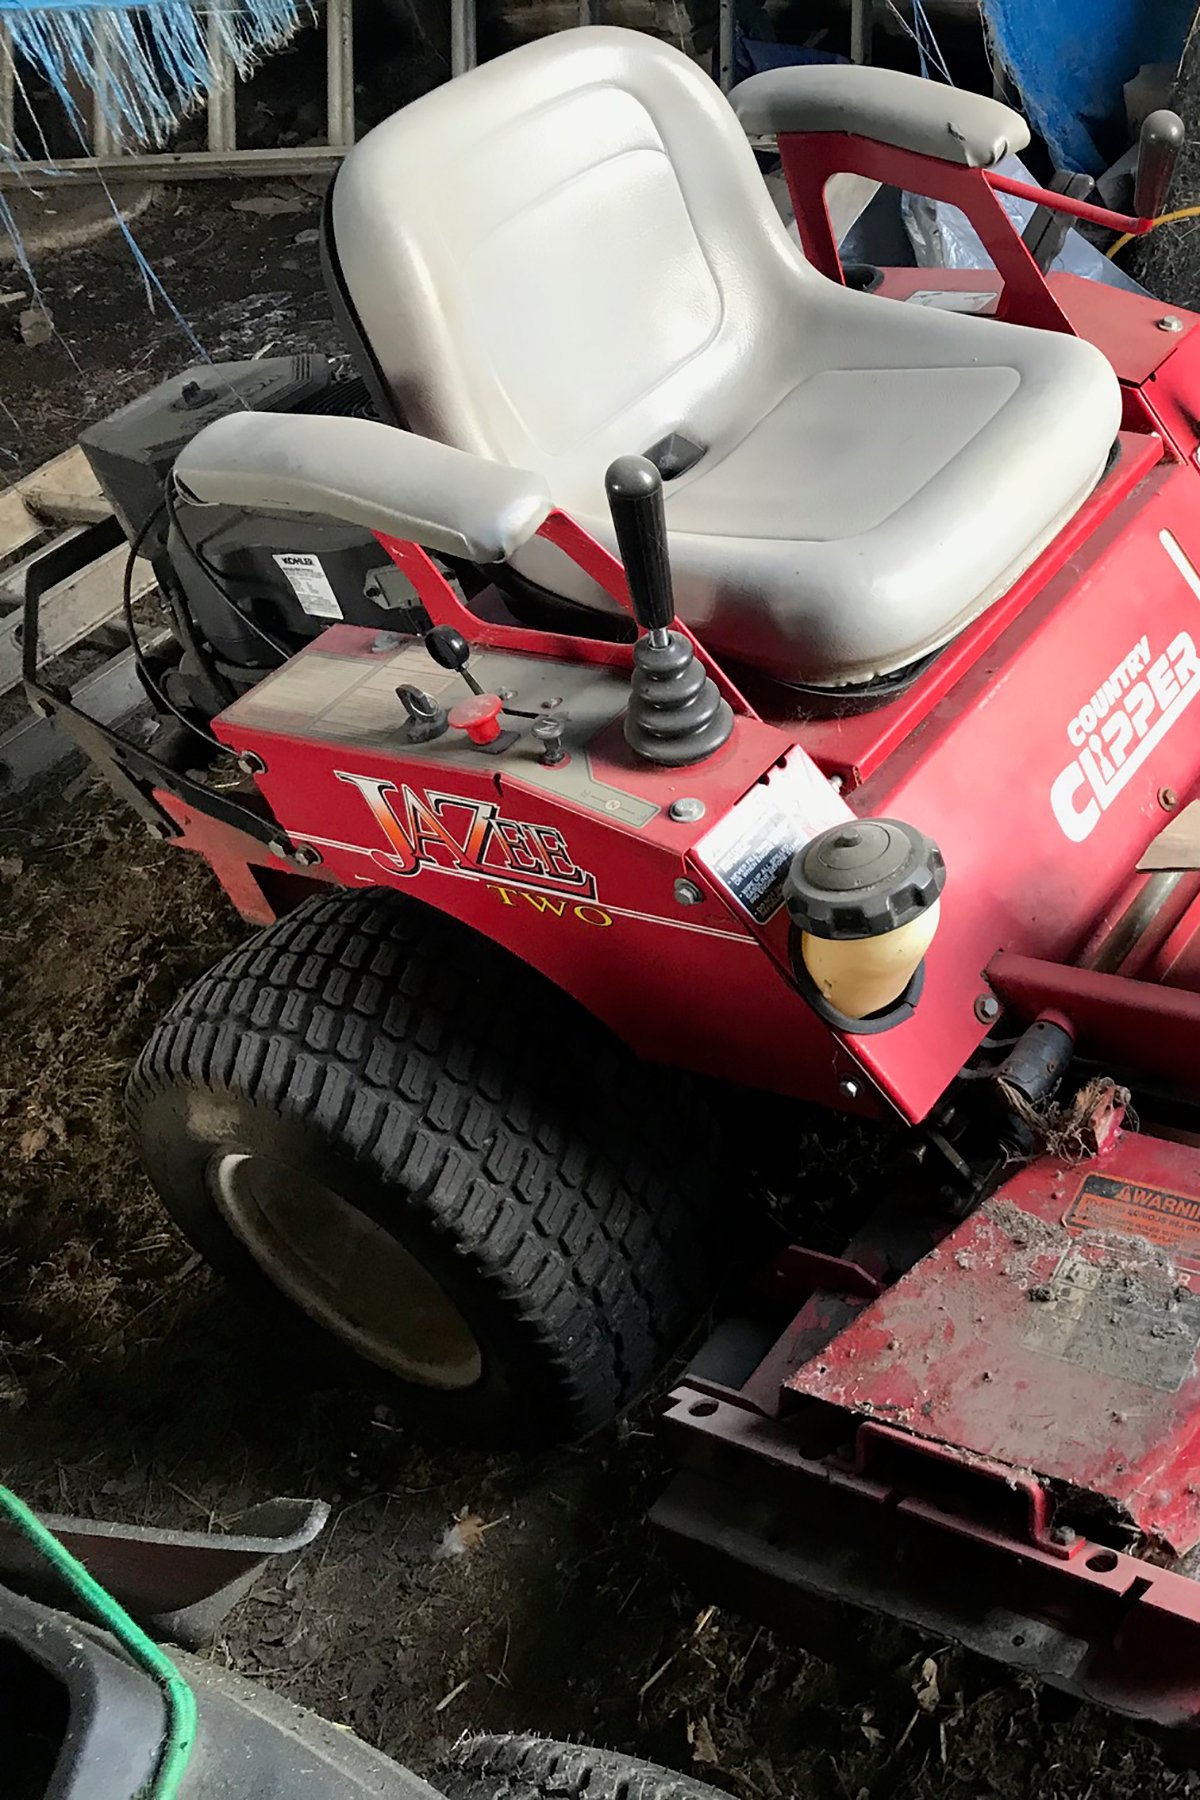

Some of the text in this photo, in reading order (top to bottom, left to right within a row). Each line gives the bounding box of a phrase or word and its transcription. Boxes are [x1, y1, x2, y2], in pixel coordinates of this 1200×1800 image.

[281, 557, 314, 565] KOHLER
[1067, 634, 1151, 747] COUNTRY
[729, 863, 747, 881] NEVER
[486, 884, 613, 927] TWO
